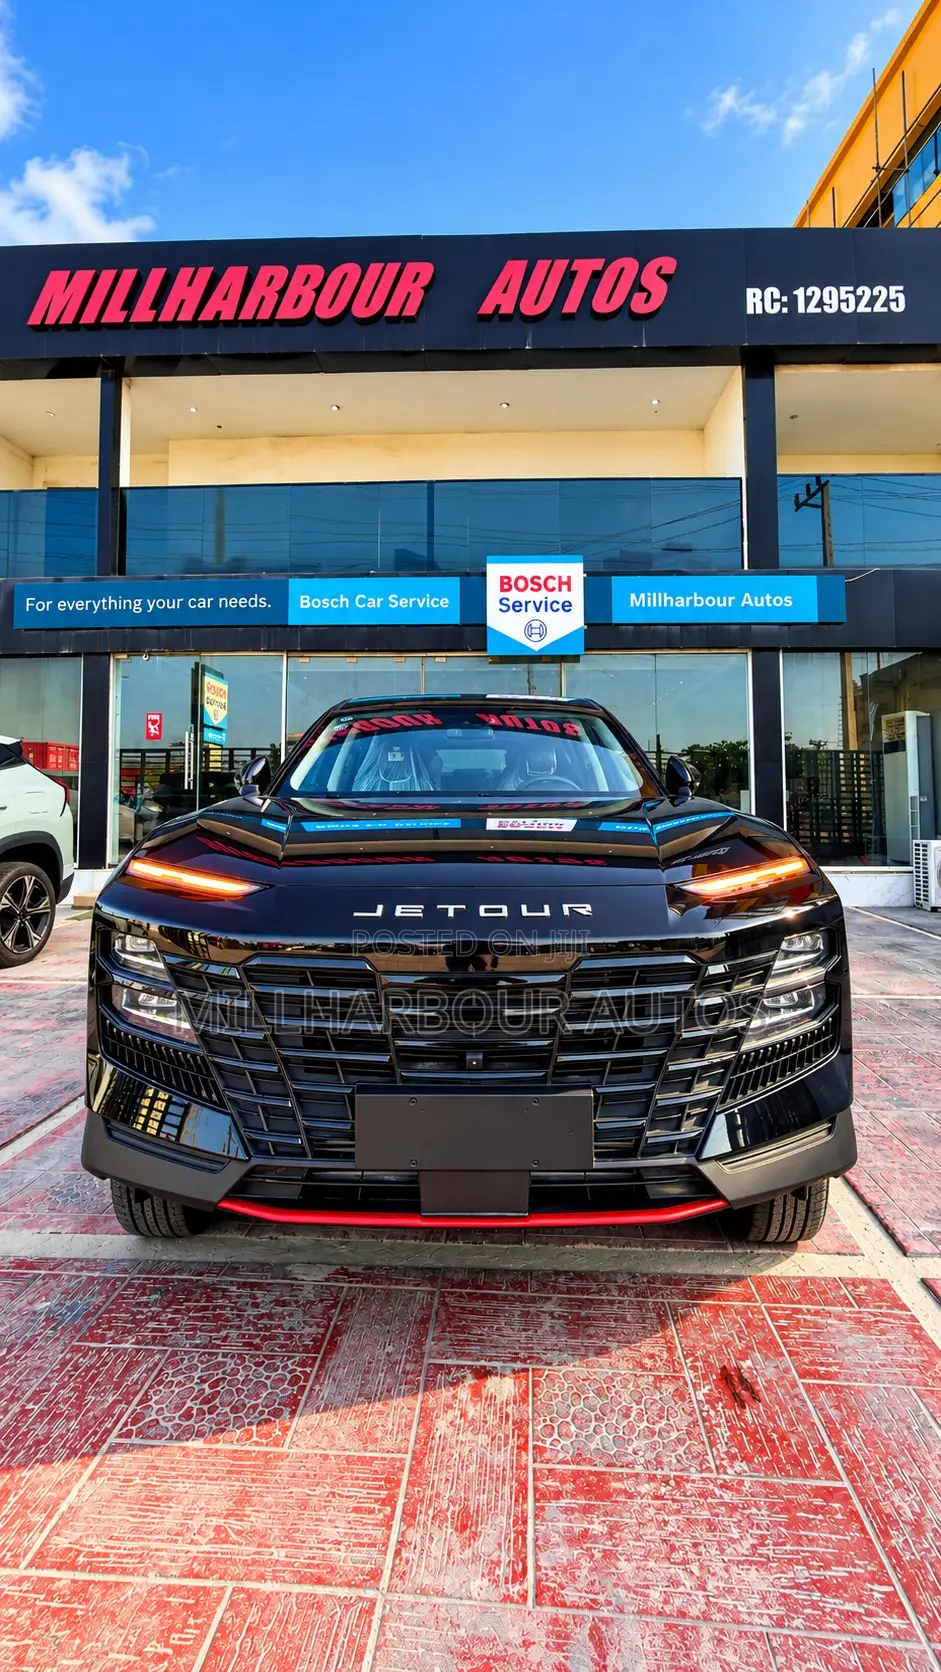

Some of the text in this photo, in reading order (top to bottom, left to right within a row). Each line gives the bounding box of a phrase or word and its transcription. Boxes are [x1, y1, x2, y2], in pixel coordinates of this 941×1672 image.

[28, 256, 678, 327] MILLHARBOUR AUTOS
[746, 285, 906, 314] RC: 1295225
[499, 575, 572, 593] BOSCH
[25, 594, 272, 614] For everything your car needs.
[299, 594, 449, 609] Bosch Car Service
[499, 597, 573, 613] Service
[630, 592, 793, 608] Millharbour Autos
[353, 904, 593, 918] JETOUR
